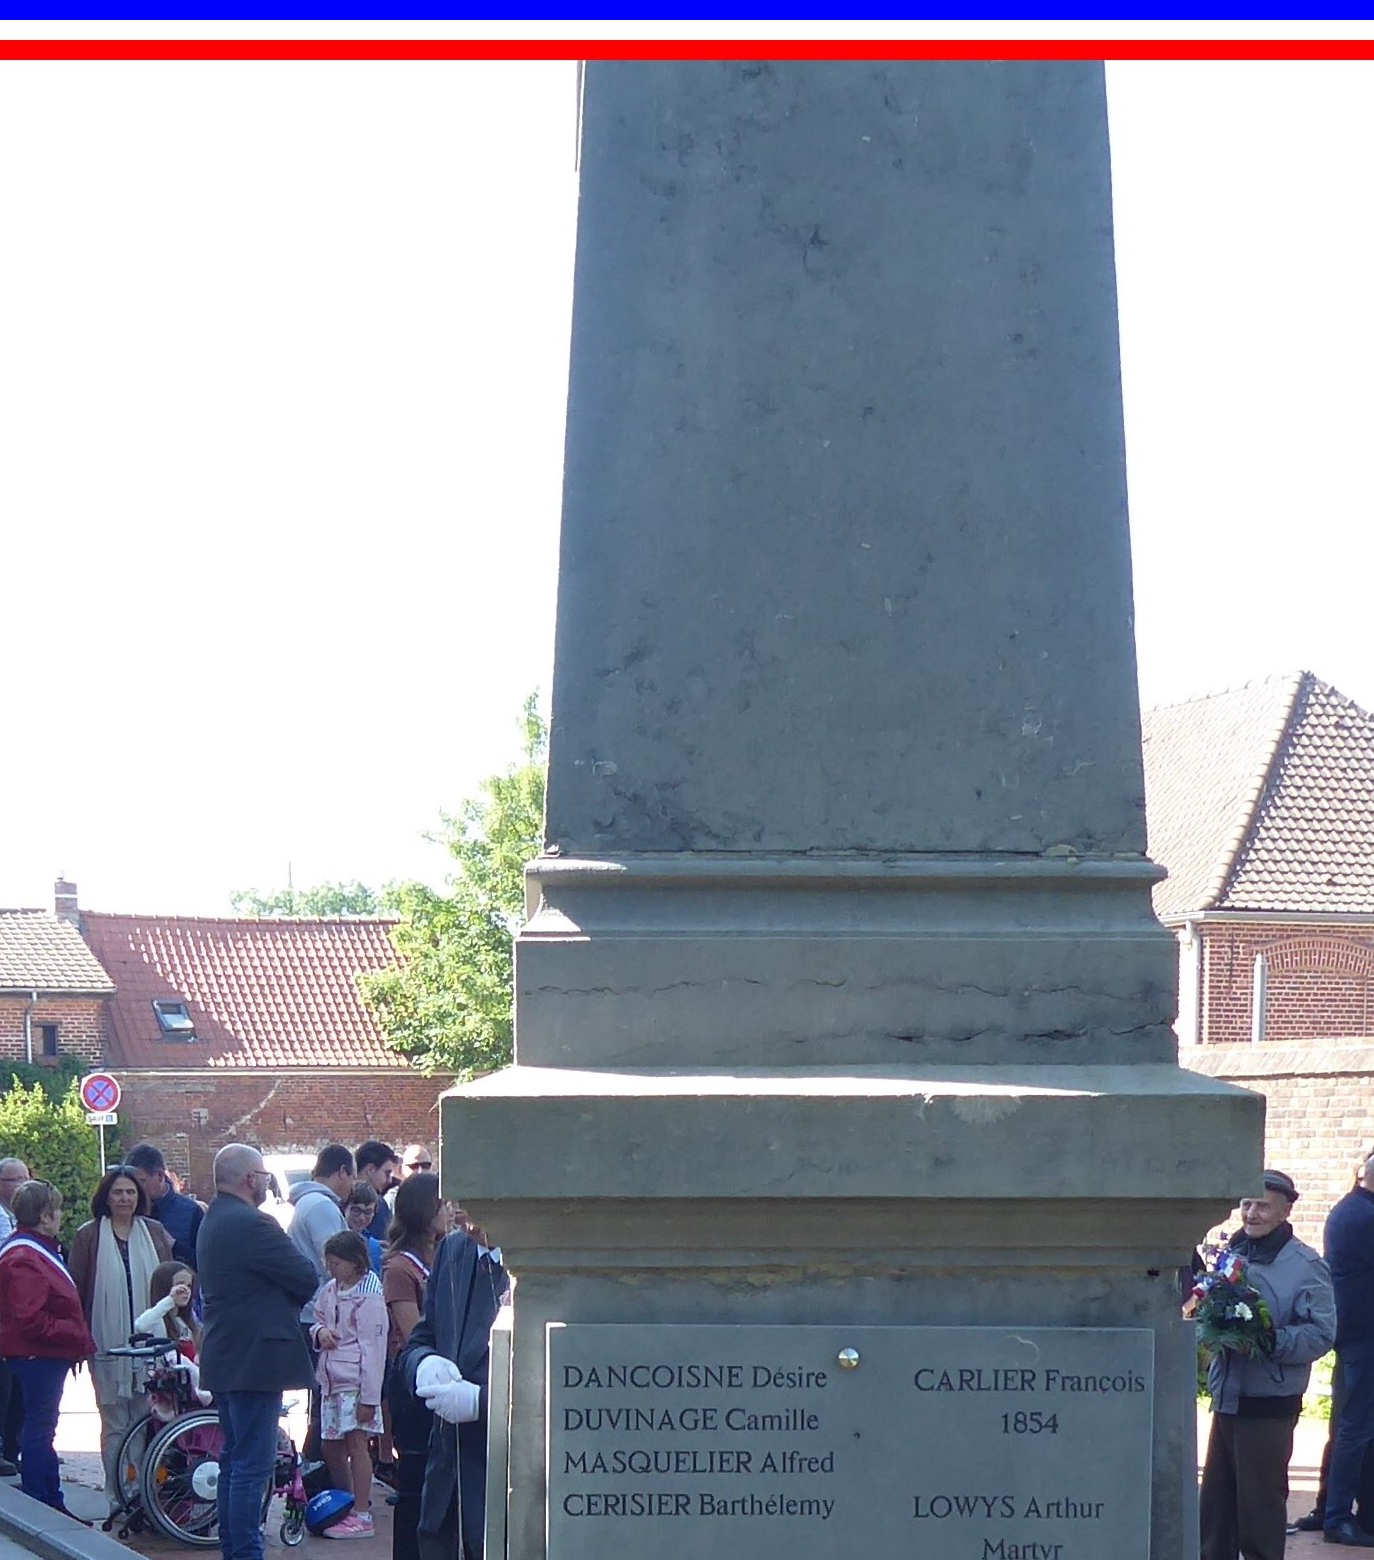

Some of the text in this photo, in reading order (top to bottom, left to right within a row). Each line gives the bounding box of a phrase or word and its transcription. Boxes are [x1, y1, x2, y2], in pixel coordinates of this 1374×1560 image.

[562, 1364, 744, 1389] DANCOISNE
[913, 1368, 1145, 1395] CARLIER François
[563, 1407, 819, 1432] DUVINAGE Camille
[1001, 1410, 1059, 1435] 1854
[563, 1450, 834, 1474] MASQUELIER Alfred
[562, 1492, 836, 1521] CERISIER Barthélemy
[913, 1495, 1105, 1519] LOWYS Arthur
